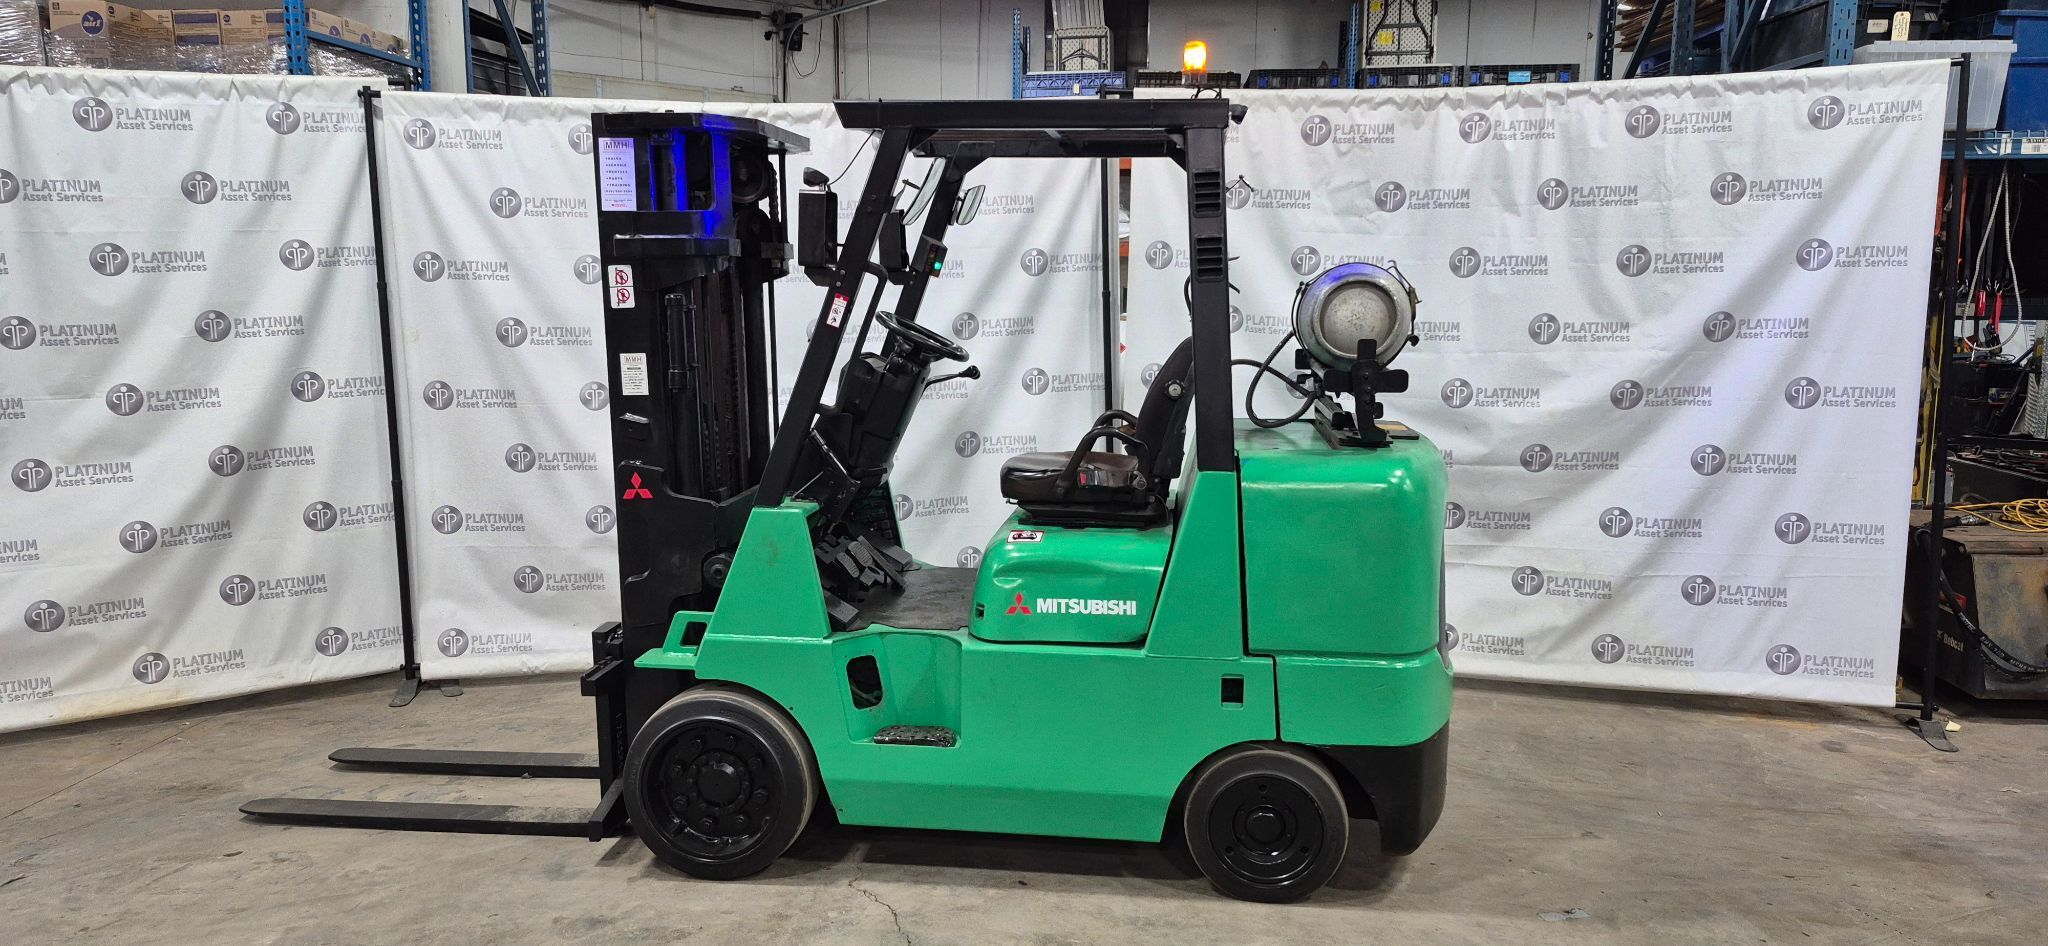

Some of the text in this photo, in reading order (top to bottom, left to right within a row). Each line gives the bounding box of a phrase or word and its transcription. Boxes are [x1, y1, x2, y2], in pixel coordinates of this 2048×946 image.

[1848, 99, 1922, 116] PLATINUM
[115, 107, 191, 122] PLATINUM
[1662, 110, 1731, 126] PLATINUM
[1845, 112, 1922, 126] Asset Services
[116, 120, 194, 131] Asset Services
[1333, 123, 1394, 136] PLATINUM
[1660, 123, 1731, 135] Asset Services
[438, 128, 501, 142] PLATINUM
[1331, 135, 1395, 145] Asset Services
[438, 139, 503, 150] Asset Services
[605, 141, 628, 150] MMH
[21, 179, 101, 193] PLATINUM
[220, 180, 290, 193] PLATINUM
[1571, 184, 1637, 199] PLATINUM
[1749, 177, 1822, 193] PLATINUM
[22, 192, 104, 203] Asset Services
[221, 192, 292, 202] Asset Services
[1252, 188, 1310, 201] PLATINUM
[1407, 188, 1469, 201] PLATINUM
[1747, 190, 1822, 203] Asset Services
[524, 196, 586, 210] PLATINUM
[1250, 199, 1310, 210] Asset Services
[1405, 200, 1469, 210] Asset Services
[1569, 197, 1638, 208] Asset Services
[523, 208, 588, 218] Asset Services
[131, 250, 205, 264] PLATINUM
[1654, 251, 1723, 265] PLATINUM
[1835, 245, 1907, 259] PLATINUM
[445, 259, 507, 273] PLATINUM
[1483, 255, 1548, 267] PLATINUM
[1833, 257, 1907, 268] Asset Services
[132, 262, 208, 274] Asset Services
[1481, 266, 1548, 276] Asset Services
[1652, 264, 1723, 275] Asset Services
[445, 271, 509, 282] Asset Services
[233, 314, 303, 330] PLATINUM
[982, 316, 1034, 330] PLATINUM
[1562, 321, 1629, 334] PLATINUM
[1737, 317, 1808, 331] PLATINUM
[38, 323, 117, 338] PLATINUM
[234, 327, 305, 339] Asset Services
[530, 326, 591, 338] PLATINUM
[981, 327, 1035, 338] Asset Services
[1735, 329, 1809, 340] Asset Services
[39, 335, 119, 347] Asset Services
[529, 337, 593, 346] Asset Services
[1423, 332, 1461, 343] Services
[1560, 333, 1630, 343] Asset Services
[327, 374, 385, 391] PLATINU
[146, 386, 220, 403] PLATINUM
[327, 387, 385, 399] Asset Servic
[455, 388, 516, 400] PLATINUM
[1475, 387, 1539, 400] PLATINUM
[1823, 385, 1896, 399] PLATINUM
[147, 399, 222, 413] Asset Services
[455, 400, 518, 409] Asset Services
[1473, 398, 1540, 408] Asset Services
[1820, 398, 1896, 408] Asset Services
[982, 434, 1036, 447] PLATINUM
[981, 445, 1037, 455] Asset Services
[537, 452, 596, 463] PLATINUM
[1555, 451, 1619, 463] PLATINUM
[1727, 452, 1796, 466] PLATINUM
[55, 461, 132, 479] PLATINUM
[537, 462, 598, 471] Asset Services
[1552, 462, 1619, 471] Asset Services
[1725, 464, 1797, 475] Asset Services
[55, 474, 134, 488] Asset Services
[915, 495, 967, 510] PLATINUM
[464, 513, 523, 524] PLATINUM
[914, 506, 968, 518] Asset Services
[1467, 510, 1530, 523] PLATINUM
[160, 519, 231, 540] PLATINUM
[464, 523, 525, 532] Asset Services
[1465, 520, 1530, 531] Asset Services
[1635, 517, 1702, 530] PLATINUM
[1813, 522, 1884, 537] PLATINUM
[1633, 529, 1702, 538] Asset Services
[1810, 533, 1885, 545] Asset Services
[160, 532, 233, 549] Asset Services
[257, 573, 326, 592] PLATINUM
[545, 572, 604, 584] PLATINUM
[1546, 575, 1611, 592] PLATINUM
[258, 586, 328, 601] Asset Services
[545, 582, 606, 592] Asset Services
[1718, 584, 1787, 599] PLATINUM
[1544, 587, 1612, 601] Asset Services
[67, 596, 144, 618] PLATINUM
[1036, 597, 1137, 616] MITSUBISHI
[1716, 595, 1787, 608] Asset Services
[68, 610, 147, 627] Asset Services
[1461, 632, 1523, 648] PLATINUM
[1459, 643, 1524, 657] Asset Services
[1627, 643, 1693, 659] PLATINUM
[172, 648, 244, 670] PLATINUM
[1625, 654, 1694, 668] Asset Services
[1803, 654, 1874, 670] PLATINUM
[173, 661, 246, 679] Asset Services
[1801, 665, 1874, 679] Asset Services
